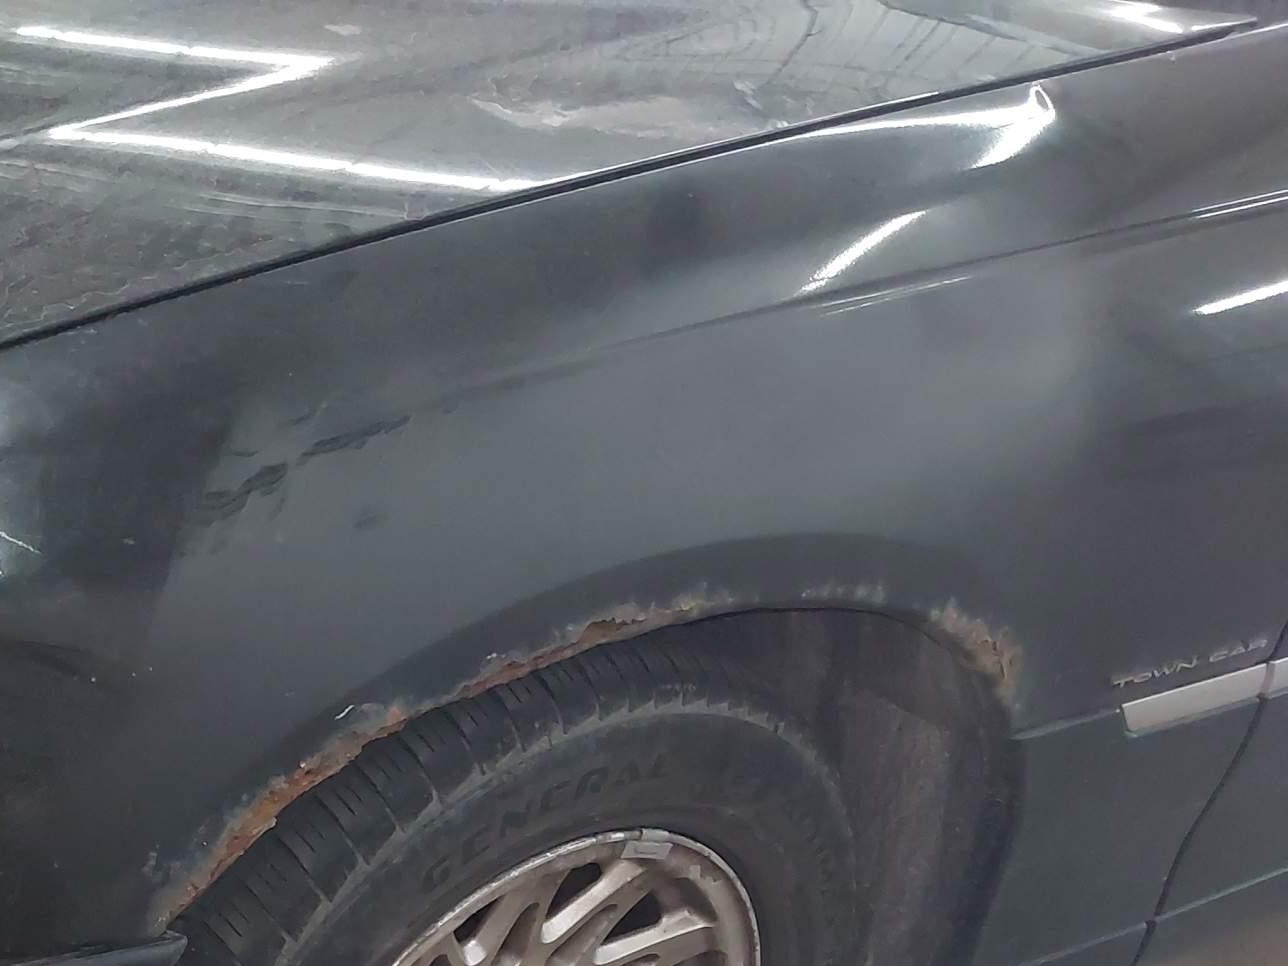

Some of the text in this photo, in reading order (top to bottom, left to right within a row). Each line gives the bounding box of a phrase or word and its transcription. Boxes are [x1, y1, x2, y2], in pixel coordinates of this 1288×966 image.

[1111, 639, 1269, 688] TOWN CAR
[421, 753, 672, 890] GENERAL
